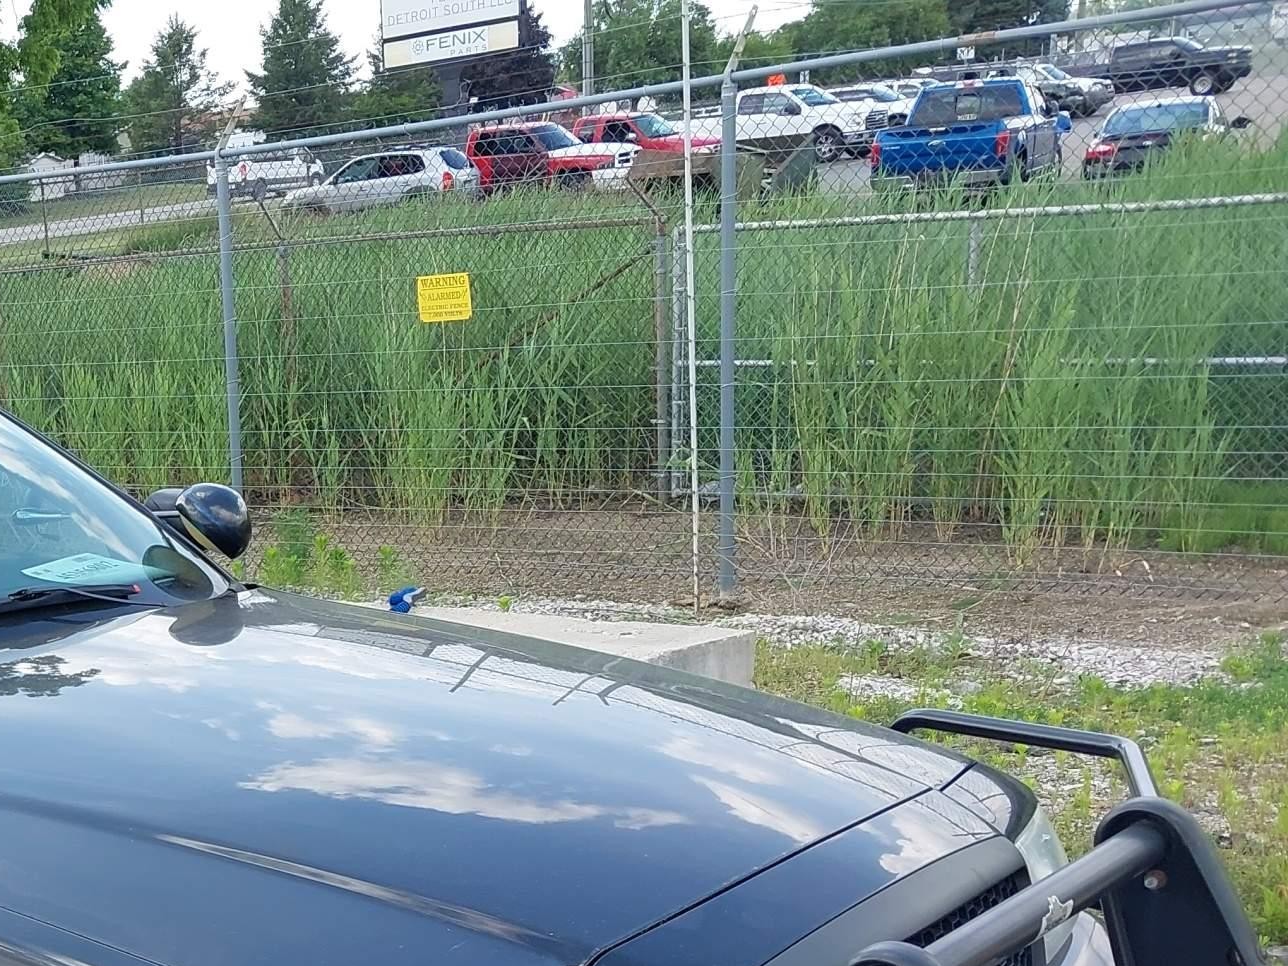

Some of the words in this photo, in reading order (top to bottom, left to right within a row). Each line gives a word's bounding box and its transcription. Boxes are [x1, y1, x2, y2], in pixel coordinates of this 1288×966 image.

[387, 6, 439, 26] DETROIT
[443, 0, 485, 16] SOUTH
[426, 29, 485, 51] FENIX
[450, 44, 487, 56] PARTS
[420, 275, 466, 288] WARNING
[427, 291, 461, 301] ALARMED
